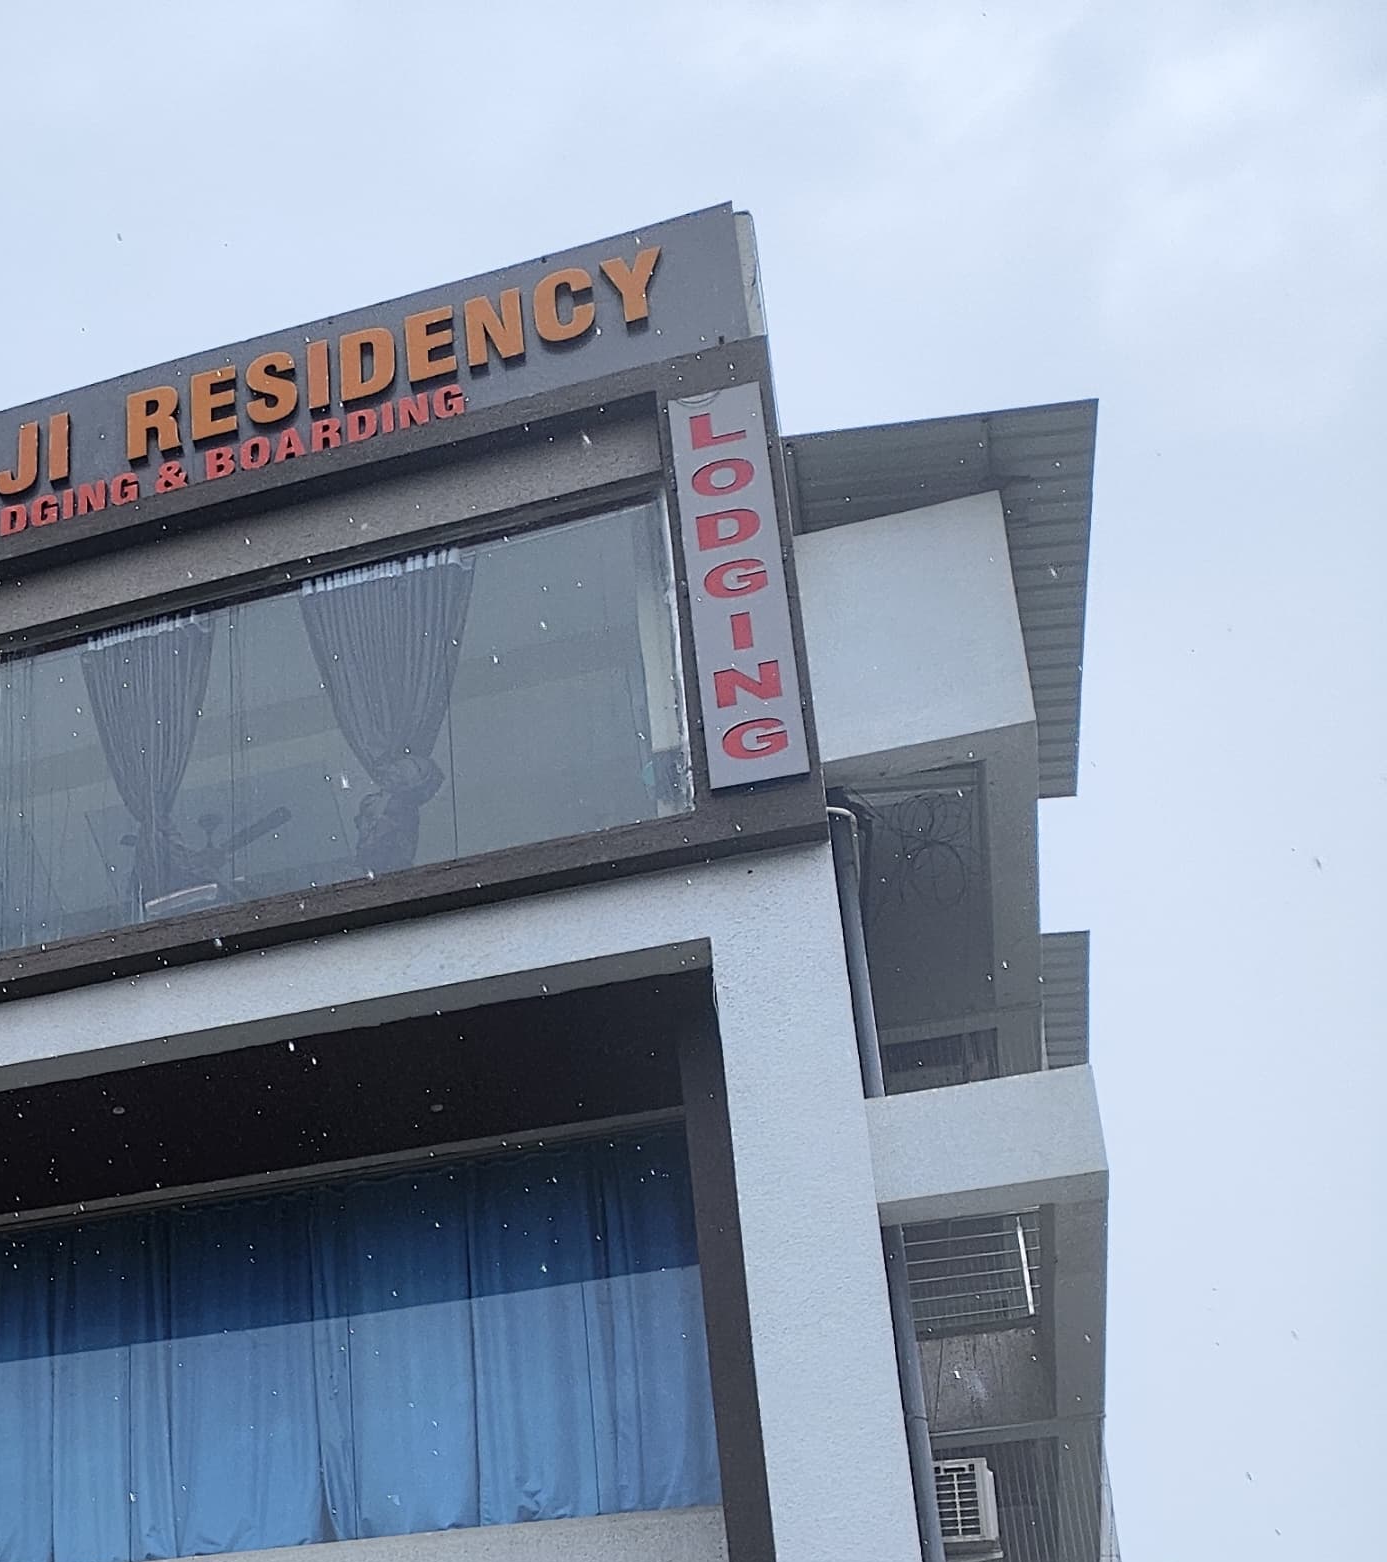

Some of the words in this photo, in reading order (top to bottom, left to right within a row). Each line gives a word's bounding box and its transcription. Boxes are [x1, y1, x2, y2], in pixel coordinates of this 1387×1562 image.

[128, 247, 663, 462] RESIDENCY
[155, 460, 189, 494] &
[204, 385, 467, 481] BOARDING
[689, 412, 789, 760] LODGING
